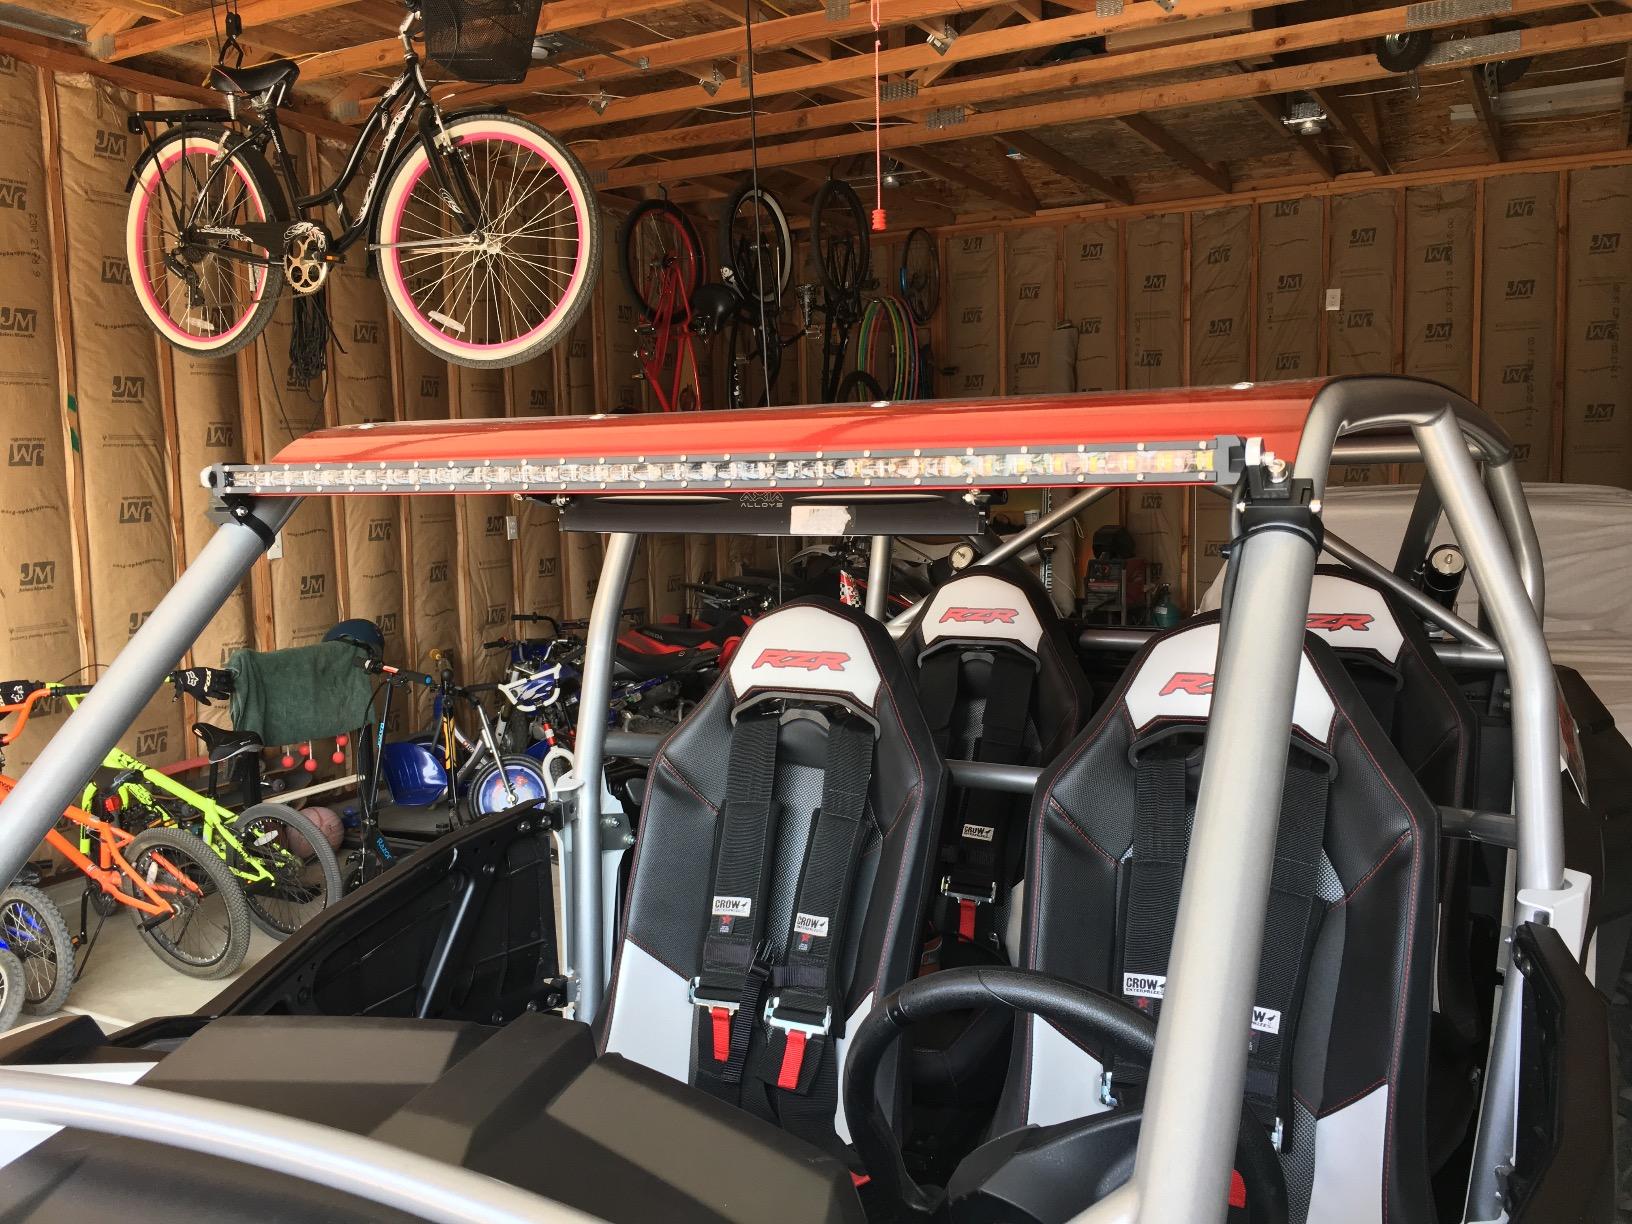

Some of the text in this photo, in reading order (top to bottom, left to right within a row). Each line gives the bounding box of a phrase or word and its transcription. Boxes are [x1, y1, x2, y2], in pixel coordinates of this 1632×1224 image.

[94, 129, 127, 154] JM
[1506, 200, 1535, 218] JM
[1349, 228, 1376, 244] JM
[1590, 233, 1621, 250] JM
[1080, 243, 1103, 258] JM
[1144, 274, 1166, 289] JM
[1277, 274, 1302, 289] JM
[1506, 280, 1535, 296] JM
[1, 306, 37, 332] JM
[1347, 312, 1373, 328] JM
[353, 323, 378, 343] JM
[1424, 323, 1452, 339] JM
[112, 376, 145, 398] JM
[1584, 404, 1615, 419] JM
[206, 426, 234, 447] JM
[8, 443, 45, 466] JM
[740, 491, 784, 501] AXIA
[119, 501, 153, 523] JM
[367, 522, 391, 541] JM
[20, 561, 55, 586] JM
[429, 564, 448, 583] JM
[538, 558, 556, 576] JM
[300, 575, 325, 595] JM
[939, 607, 1019, 624] RZR
[1305, 613, 1375, 631] ZR
[752, 648, 851, 671] RZR
[136, 730, 168, 757] JM
[964, 826, 986, 835] CROW
[376, 837, 392, 860] Razor
[714, 899, 741, 909] CROW
[797, 915, 820, 929] CROW
[1125, 977, 1158, 990] CROW
